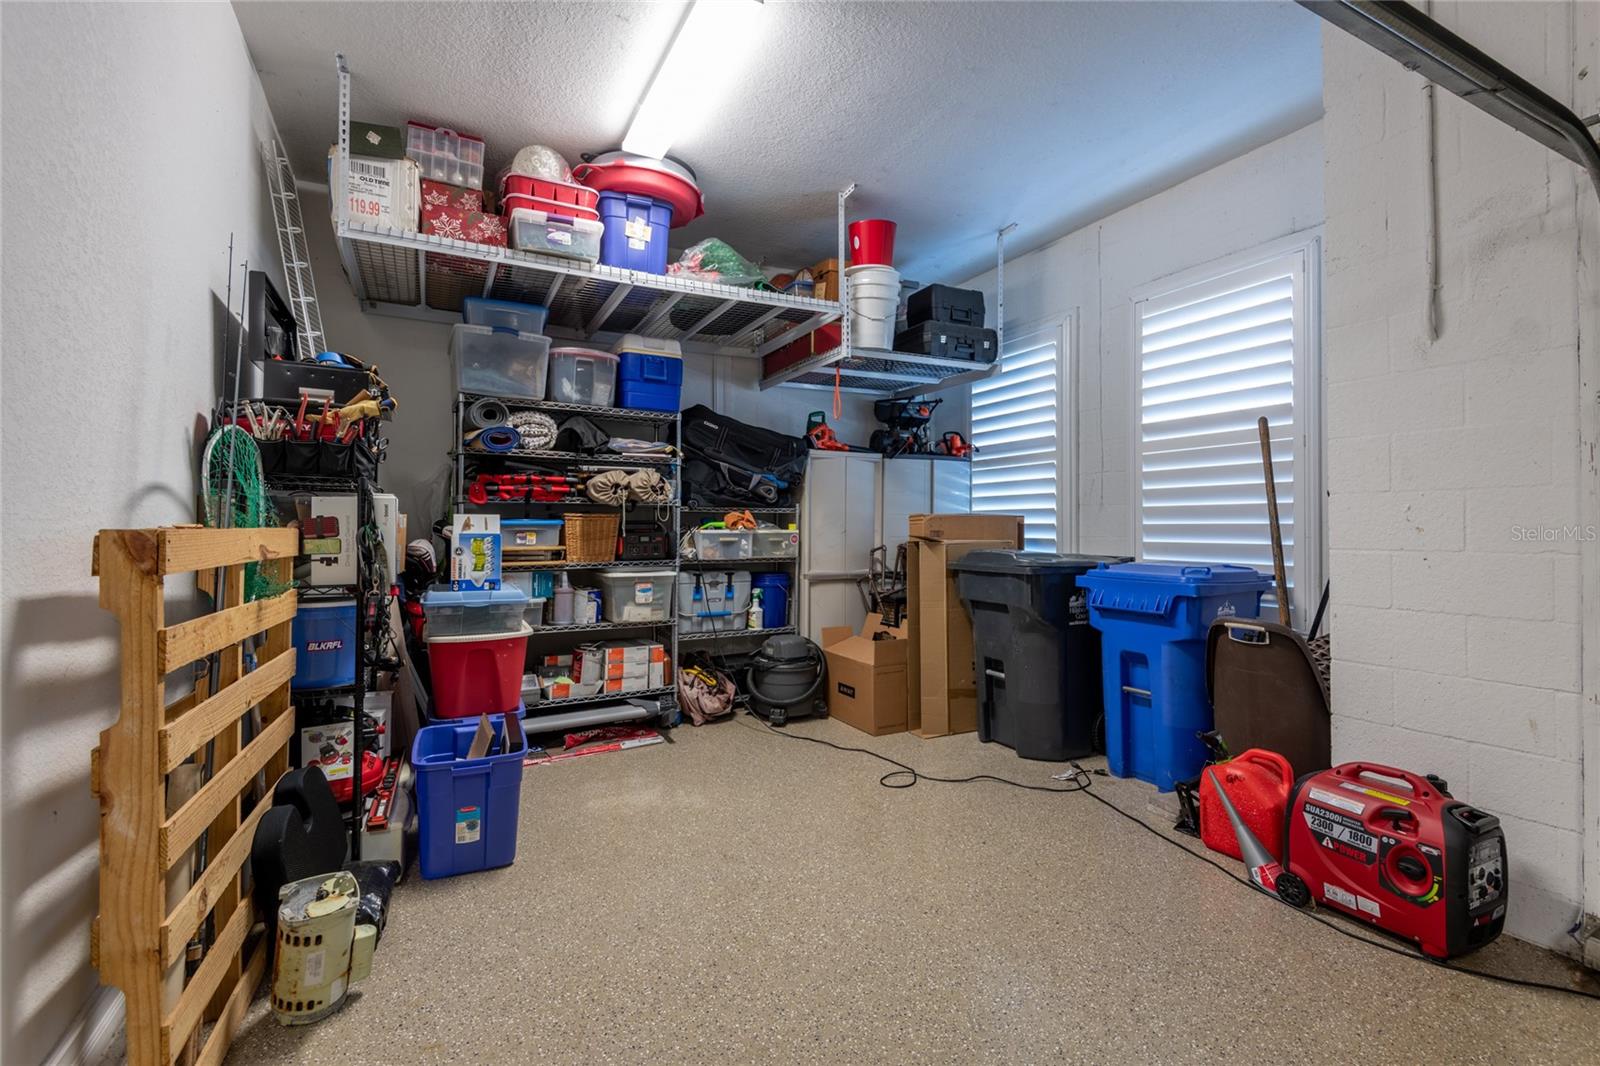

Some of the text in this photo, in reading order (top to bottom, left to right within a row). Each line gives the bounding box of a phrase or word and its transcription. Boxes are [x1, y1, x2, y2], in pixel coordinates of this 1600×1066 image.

[350, 197, 379, 216] 119.99
[307, 640, 343, 651] BLKRFL
[1305, 804, 1343, 823] SUA2300i
[1311, 816, 1334, 832] 2300
[1348, 830, 1372, 846] 1800
